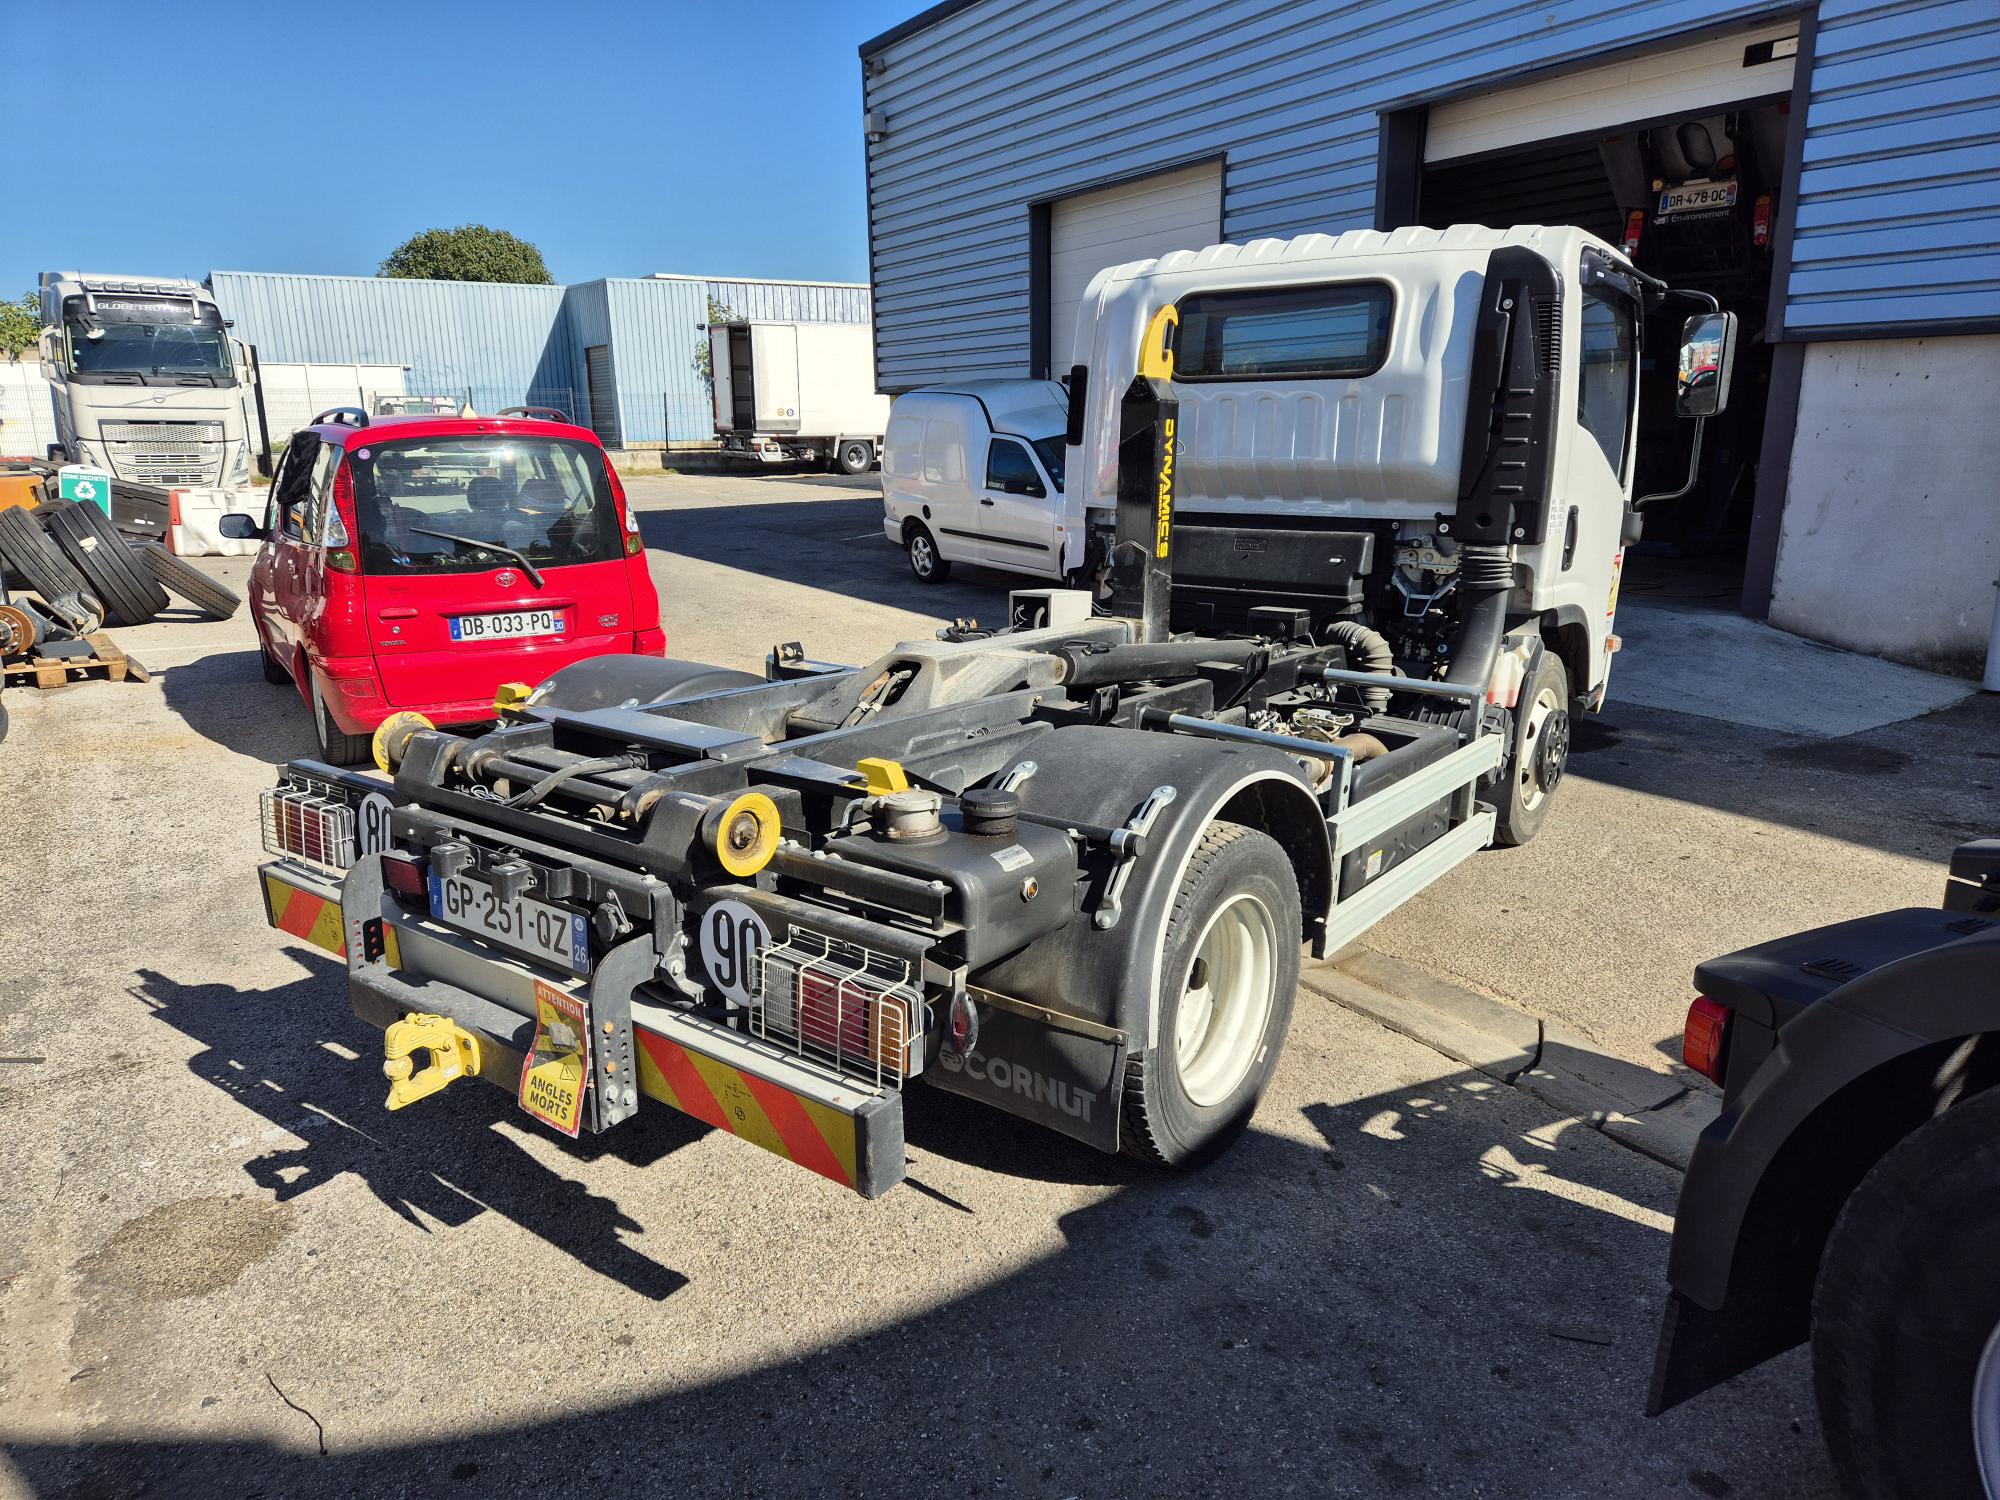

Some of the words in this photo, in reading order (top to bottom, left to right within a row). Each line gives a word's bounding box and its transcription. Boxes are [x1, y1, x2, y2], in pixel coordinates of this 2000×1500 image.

[462, 613, 551, 636] DB-033-PQ
[555, 620, 564, 629] 30
[445, 878, 569, 957] GP-251-QZ
[574, 945, 587, 963] 26
[713, 909, 762, 998] 90
[537, 985, 582, 1019] ATTENTION
[531, 1075, 573, 1106] ANGLES
[964, 1052, 1097, 1123] CORNUT
[529, 1091, 568, 1120] MORTS
